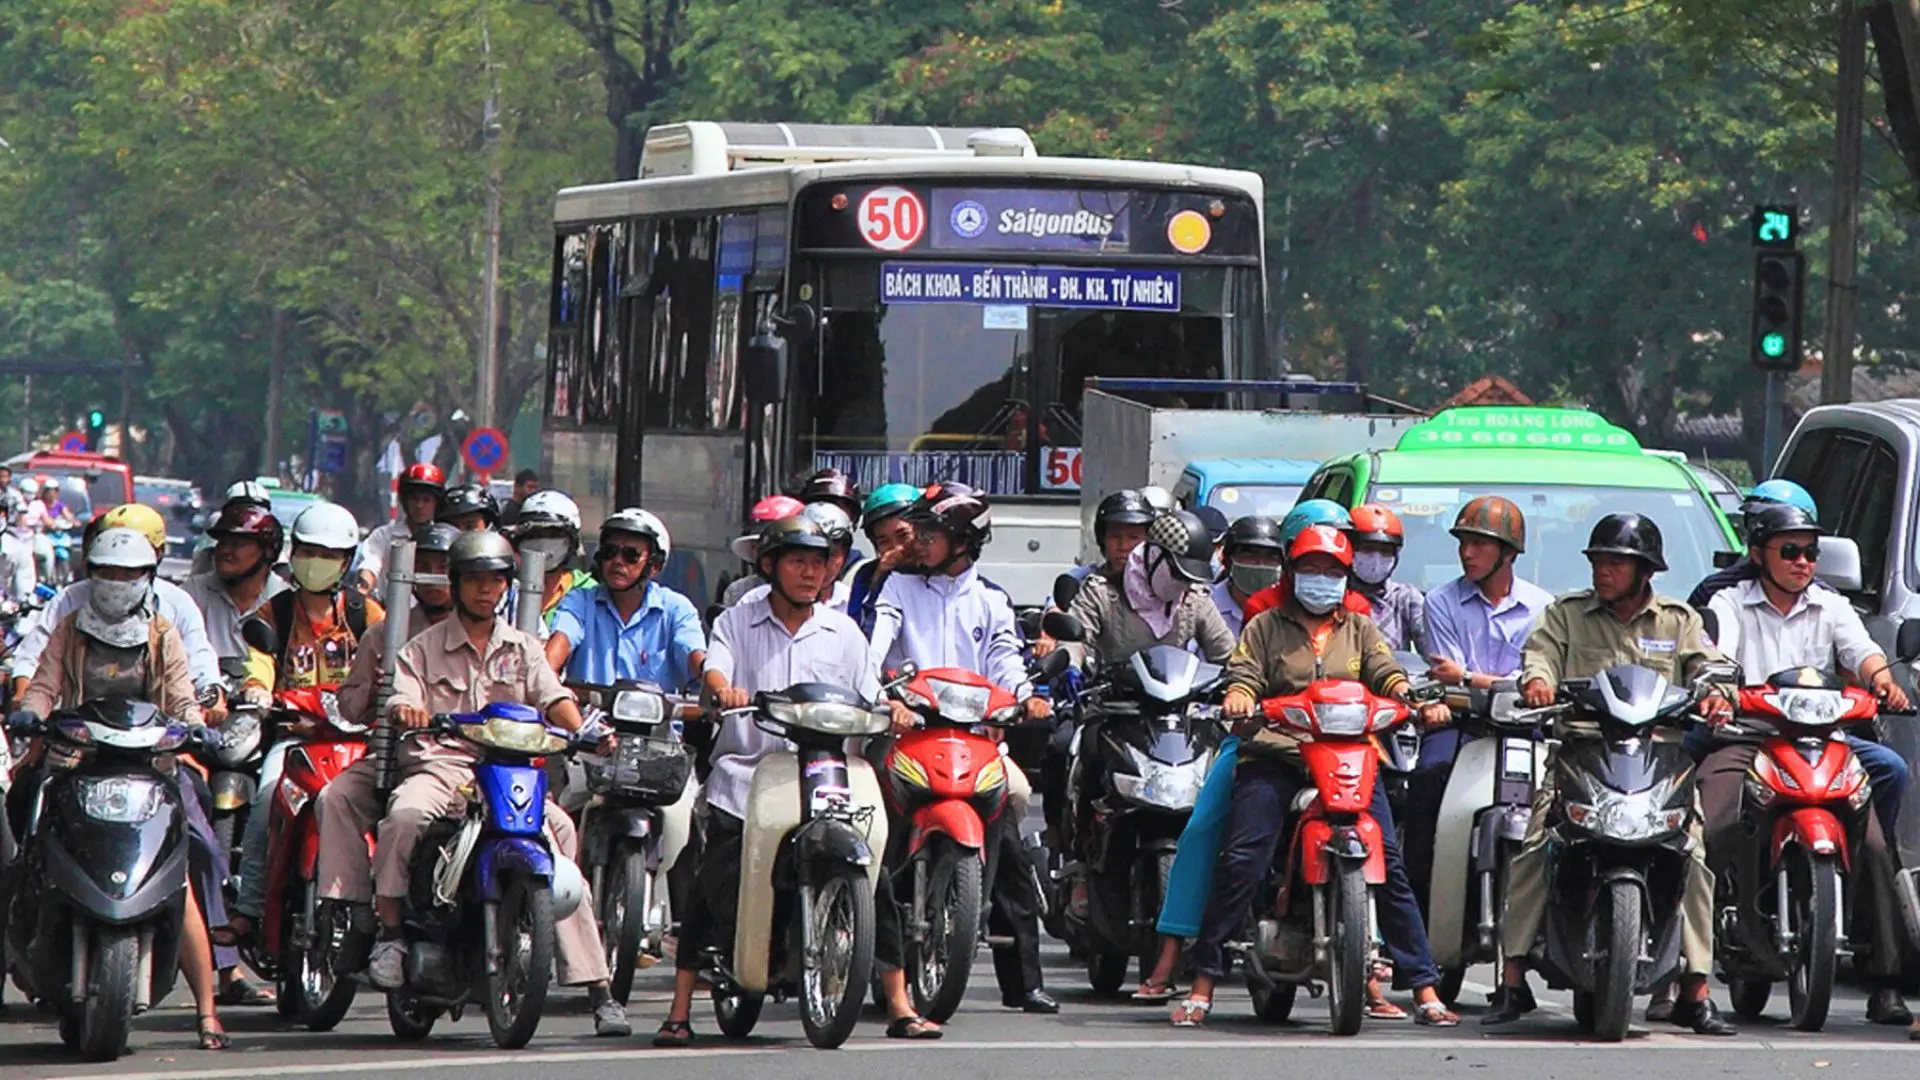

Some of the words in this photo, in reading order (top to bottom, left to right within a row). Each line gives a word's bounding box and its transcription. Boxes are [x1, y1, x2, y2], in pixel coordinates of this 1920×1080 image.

[867, 196, 918, 242] 50
[998, 208, 1112, 238] SaigonBus
[1759, 211, 1789, 241] 24
[885, 267, 921, 297] BÁCH
[925, 273, 961, 297] KHOA
[972, 268, 1000, 298] BẾN
[1003, 270, 1048, 299] THÀNH
[1086, 277, 1109, 301] KH.
[1133, 275, 1173, 304] NHIÊN
[1551, 413, 1597, 429] LONG
